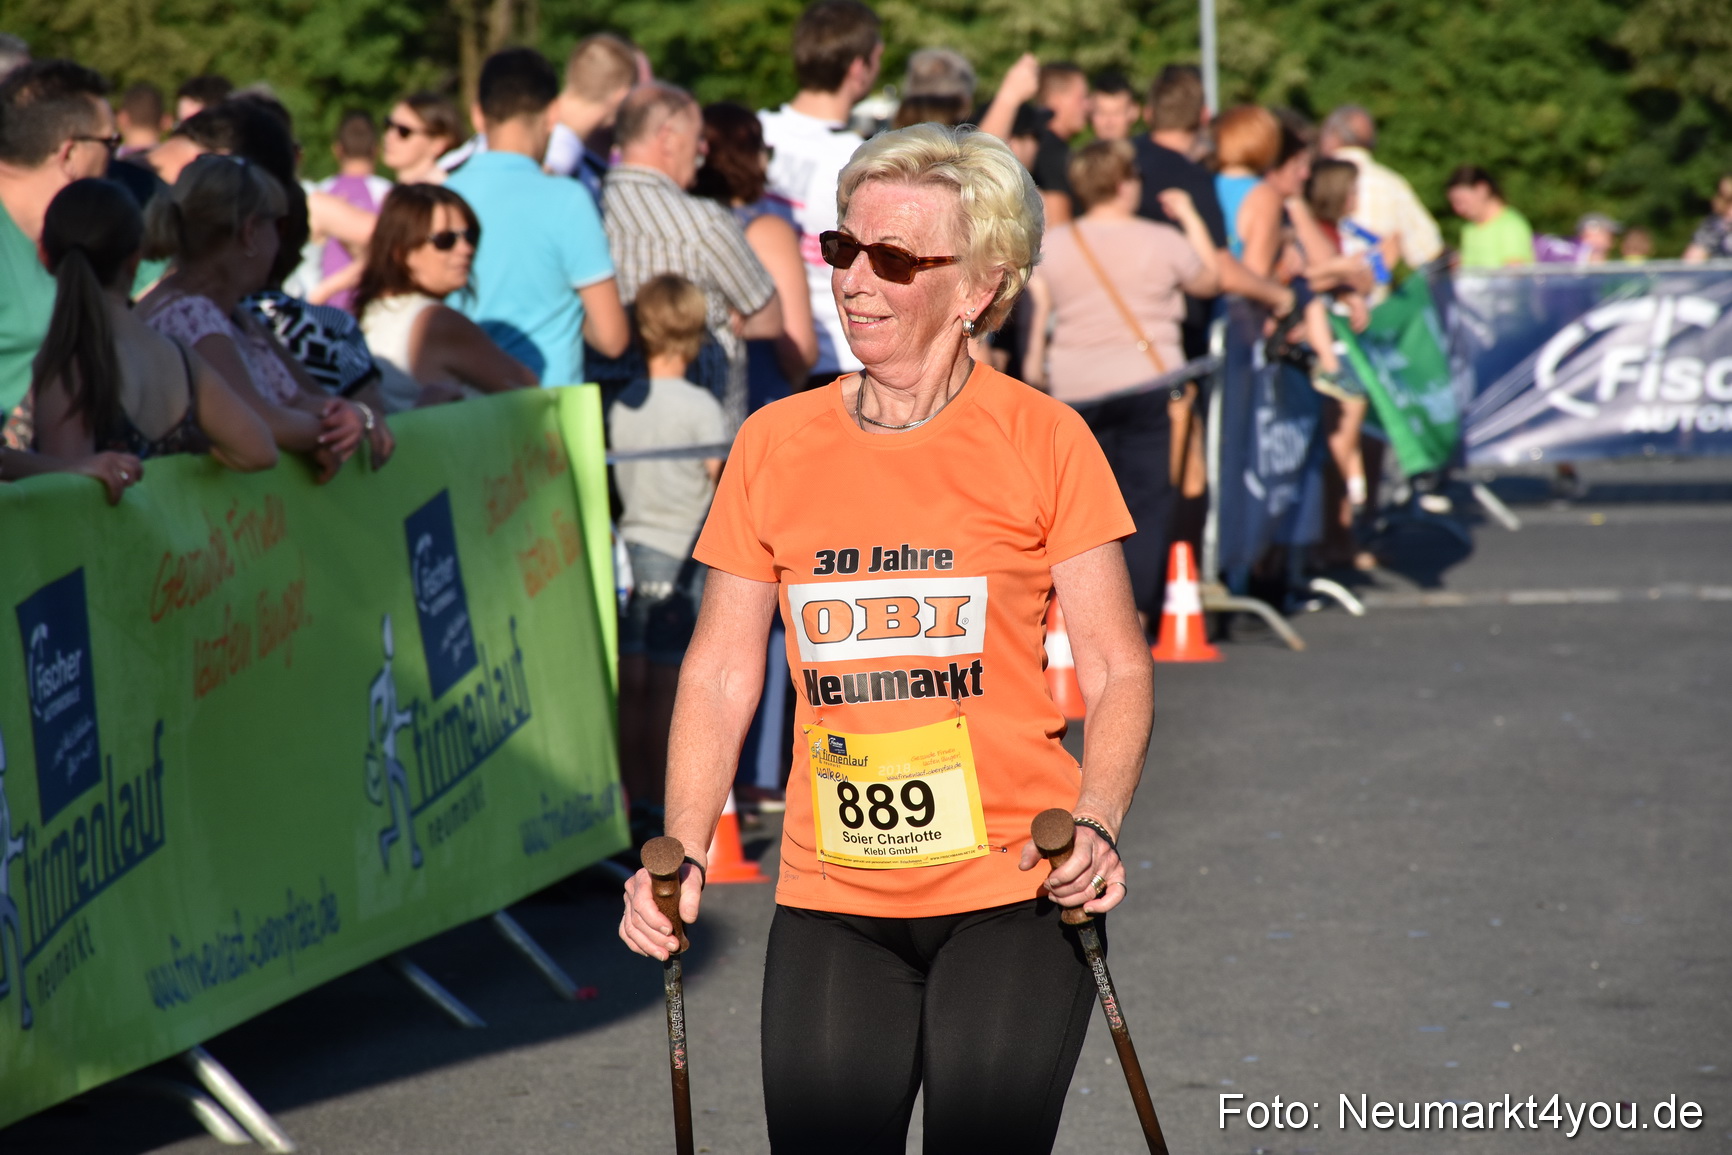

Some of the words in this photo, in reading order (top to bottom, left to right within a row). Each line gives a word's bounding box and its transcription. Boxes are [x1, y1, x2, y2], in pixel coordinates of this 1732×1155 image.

[813, 548, 860, 575] 30
[868, 544, 954, 573] Jahre
[802, 596, 970, 644] OBI
[36, 648, 82, 703] Fischer
[802, 659, 984, 707] Neumarkt
[410, 615, 532, 802] firmenlauf
[822, 749, 868, 766] firmenlauf
[878, 763, 911, 776] 2018
[837, 780, 935, 830] 889
[22, 718, 166, 955] firmenlauf
[843, 830, 873, 845] Soier
[877, 830, 942, 845] Charlotte
[863, 847, 887, 856] Klebl
[888, 846, 919, 856] GmbH
